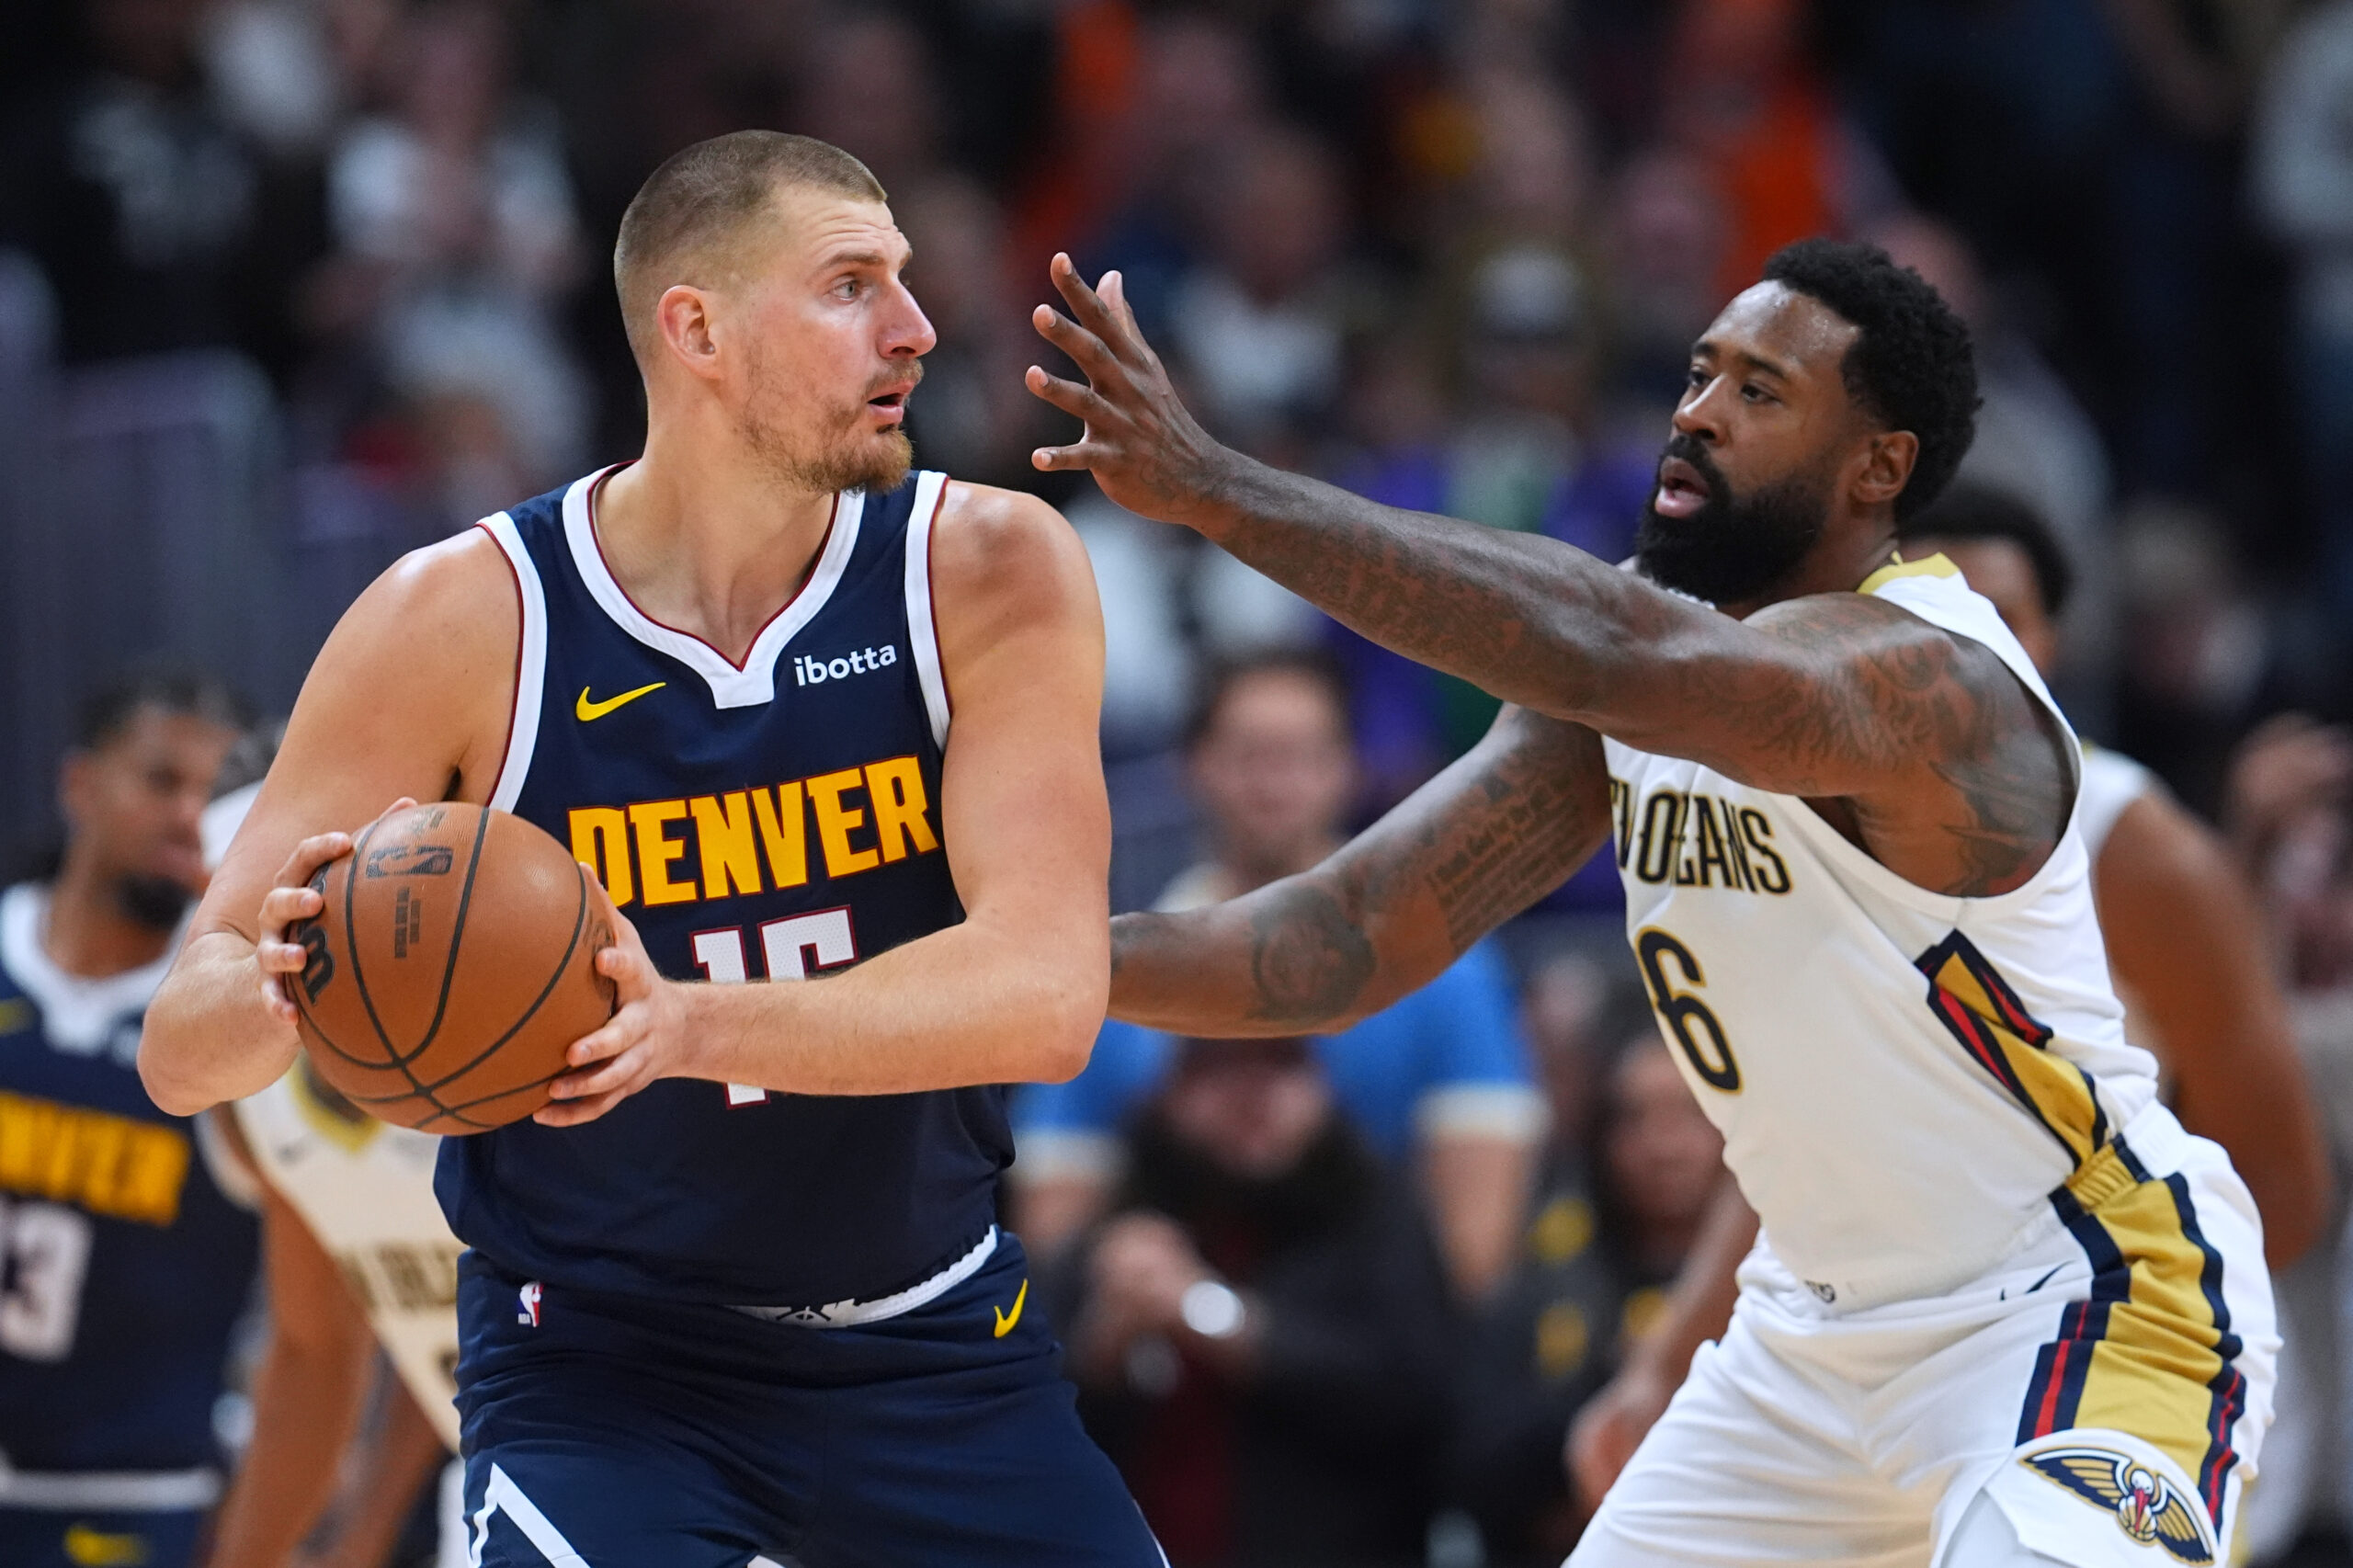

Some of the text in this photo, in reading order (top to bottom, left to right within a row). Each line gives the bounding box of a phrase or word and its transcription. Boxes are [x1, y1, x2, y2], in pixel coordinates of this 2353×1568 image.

[794, 644, 897, 687] ibotta
[567, 755, 939, 909] DENVER
[1634, 925, 1743, 1095] 6
